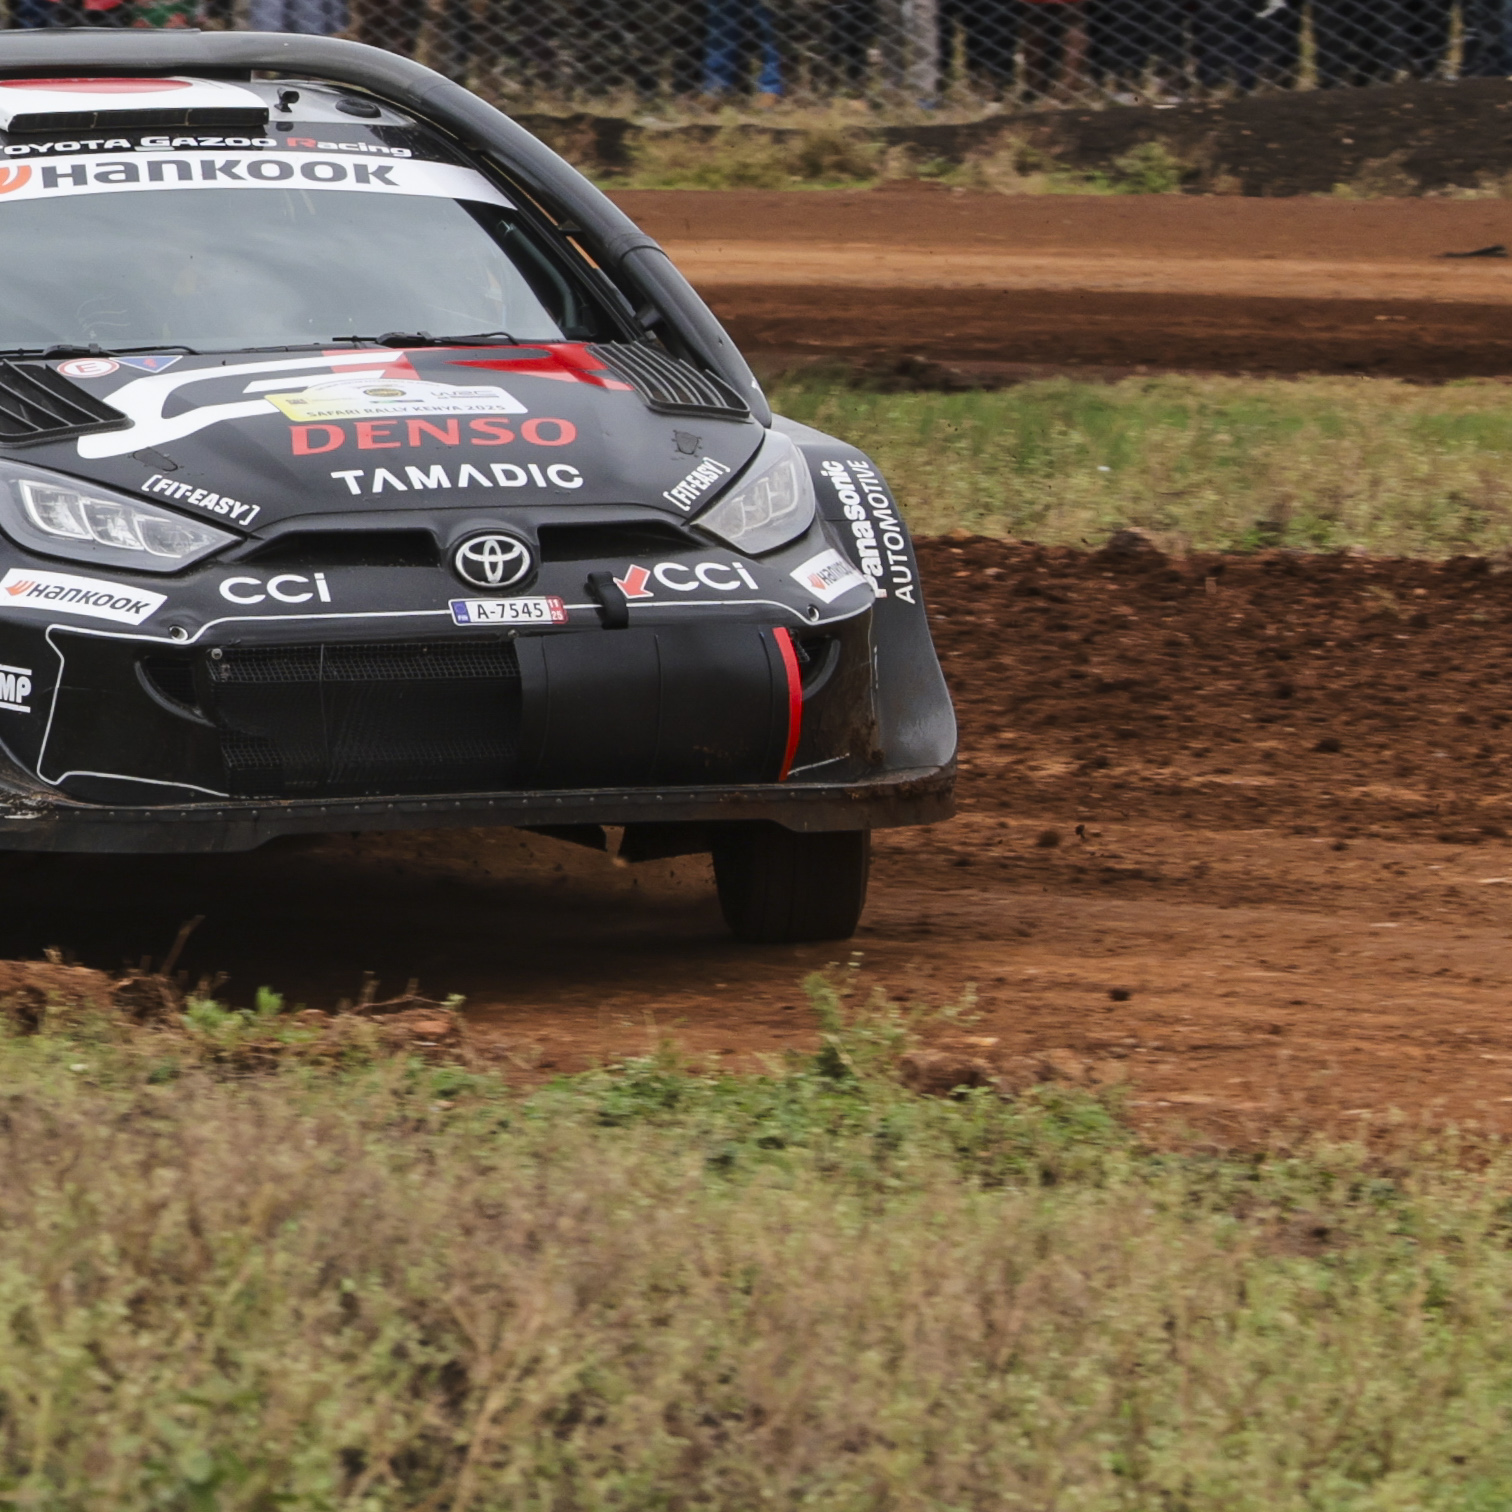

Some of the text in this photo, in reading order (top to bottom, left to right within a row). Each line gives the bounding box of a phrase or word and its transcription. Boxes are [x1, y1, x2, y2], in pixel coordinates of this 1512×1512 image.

[138, 136, 276, 150] GAZOO
[287, 137, 412, 157] Racing
[306, 403, 507, 419] SAFARI RALLY KENYA 2025
[288, 417, 578, 456] DENSO
[330, 463, 584, 496] TAMADIC
[820, 460, 888, 599] Panasonic
[846, 459, 916, 605] AUTOMOTIVE
[477, 602, 543, 620] A-7545
[547, 598, 559, 608] 11
[551, 610, 563, 621] 25
